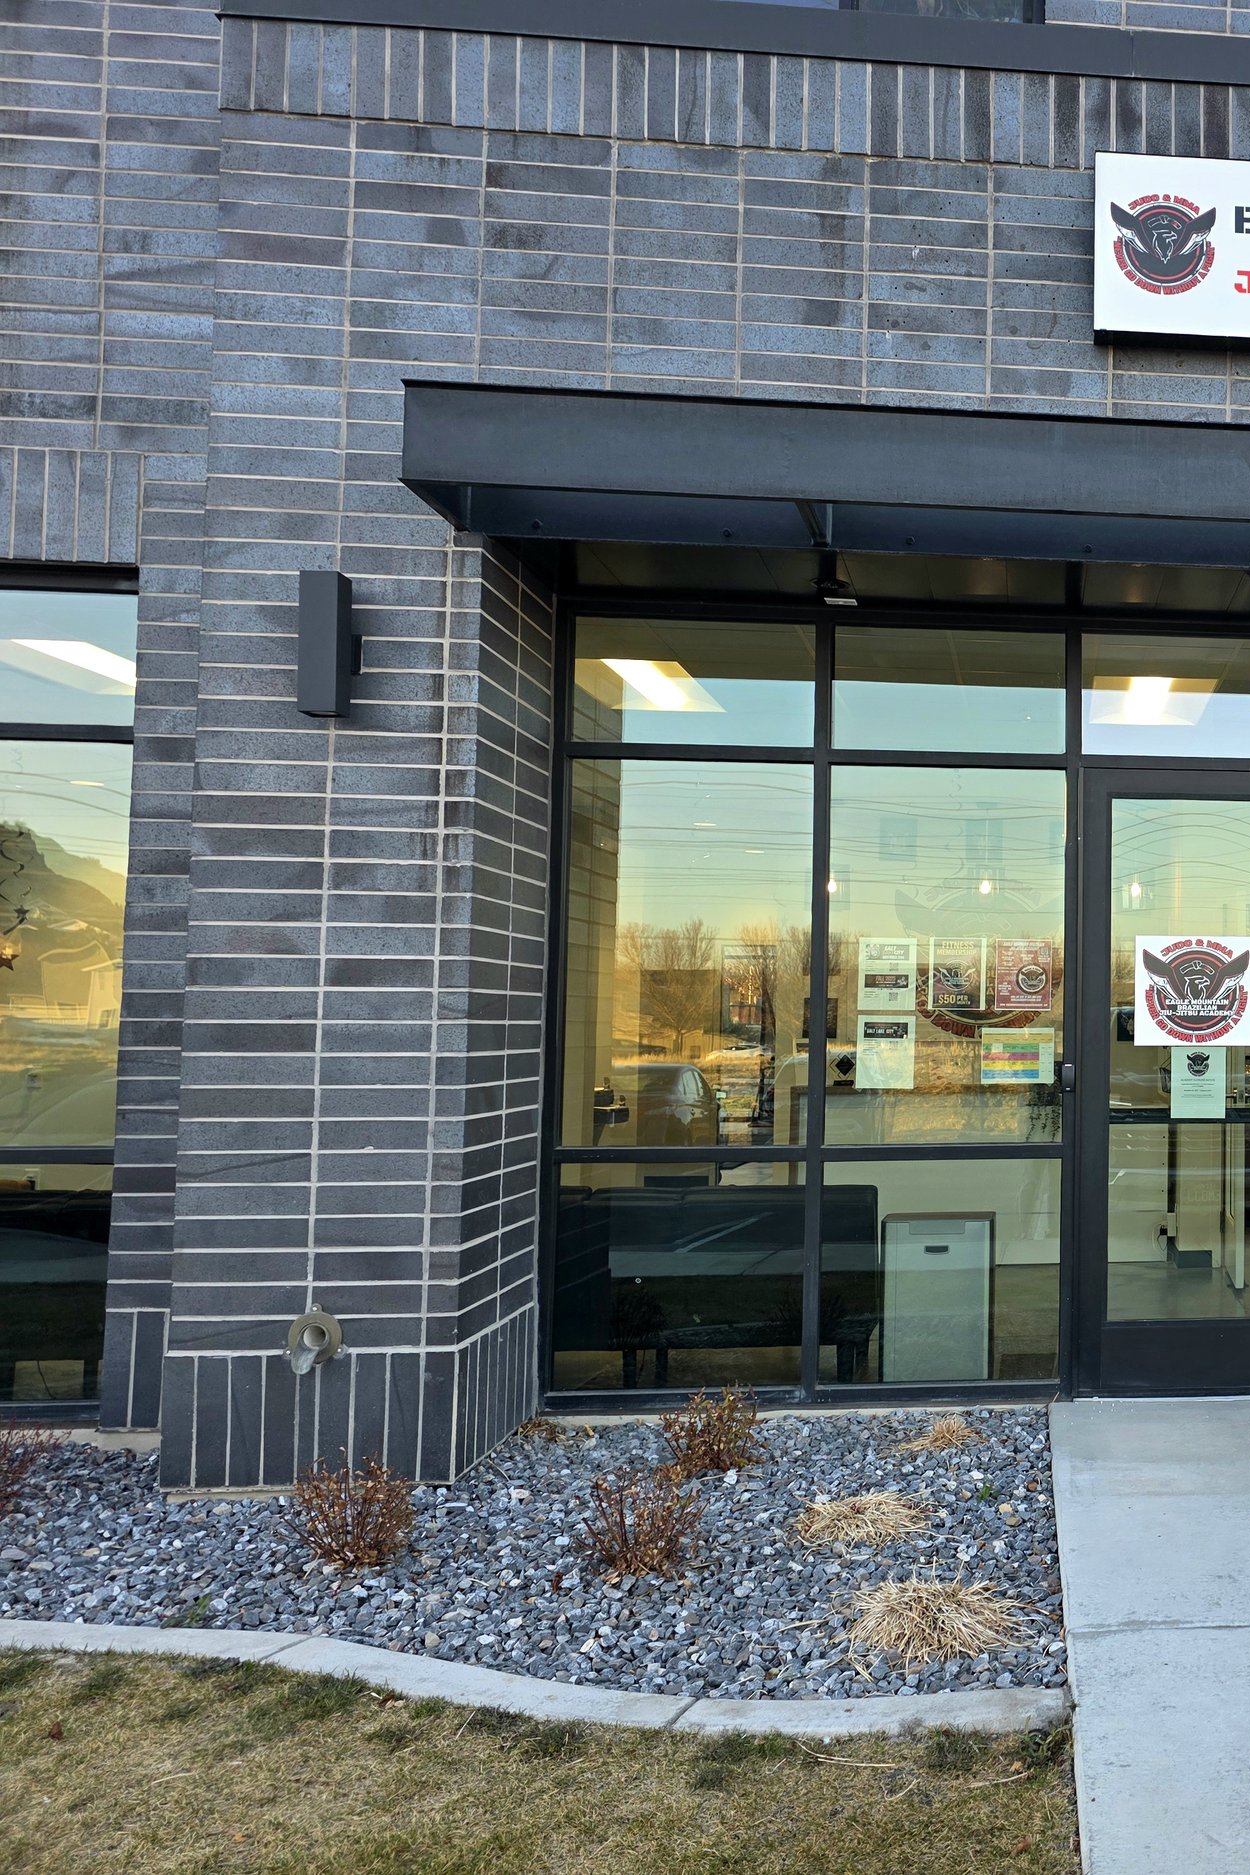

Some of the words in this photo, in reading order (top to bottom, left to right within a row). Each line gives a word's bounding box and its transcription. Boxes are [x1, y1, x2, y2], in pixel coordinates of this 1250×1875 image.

[1128, 194, 1160, 210] JUDO
[1162, 194, 1171, 202] &
[1174, 195, 1200, 215] MMA
[1134, 277, 1161, 295] DOWN
[1198, 271, 1208, 280] A
[942, 941, 974, 949] FITNESS
[1161, 940, 1193, 957] JUDO
[1195, 939, 1204, 947] &
[1207, 940, 1234, 959] MMA
[939, 994, 955, 1004] $50
[1166, 1027, 1193, 1043] DOWN
[1230, 1017, 1241, 1025] A
